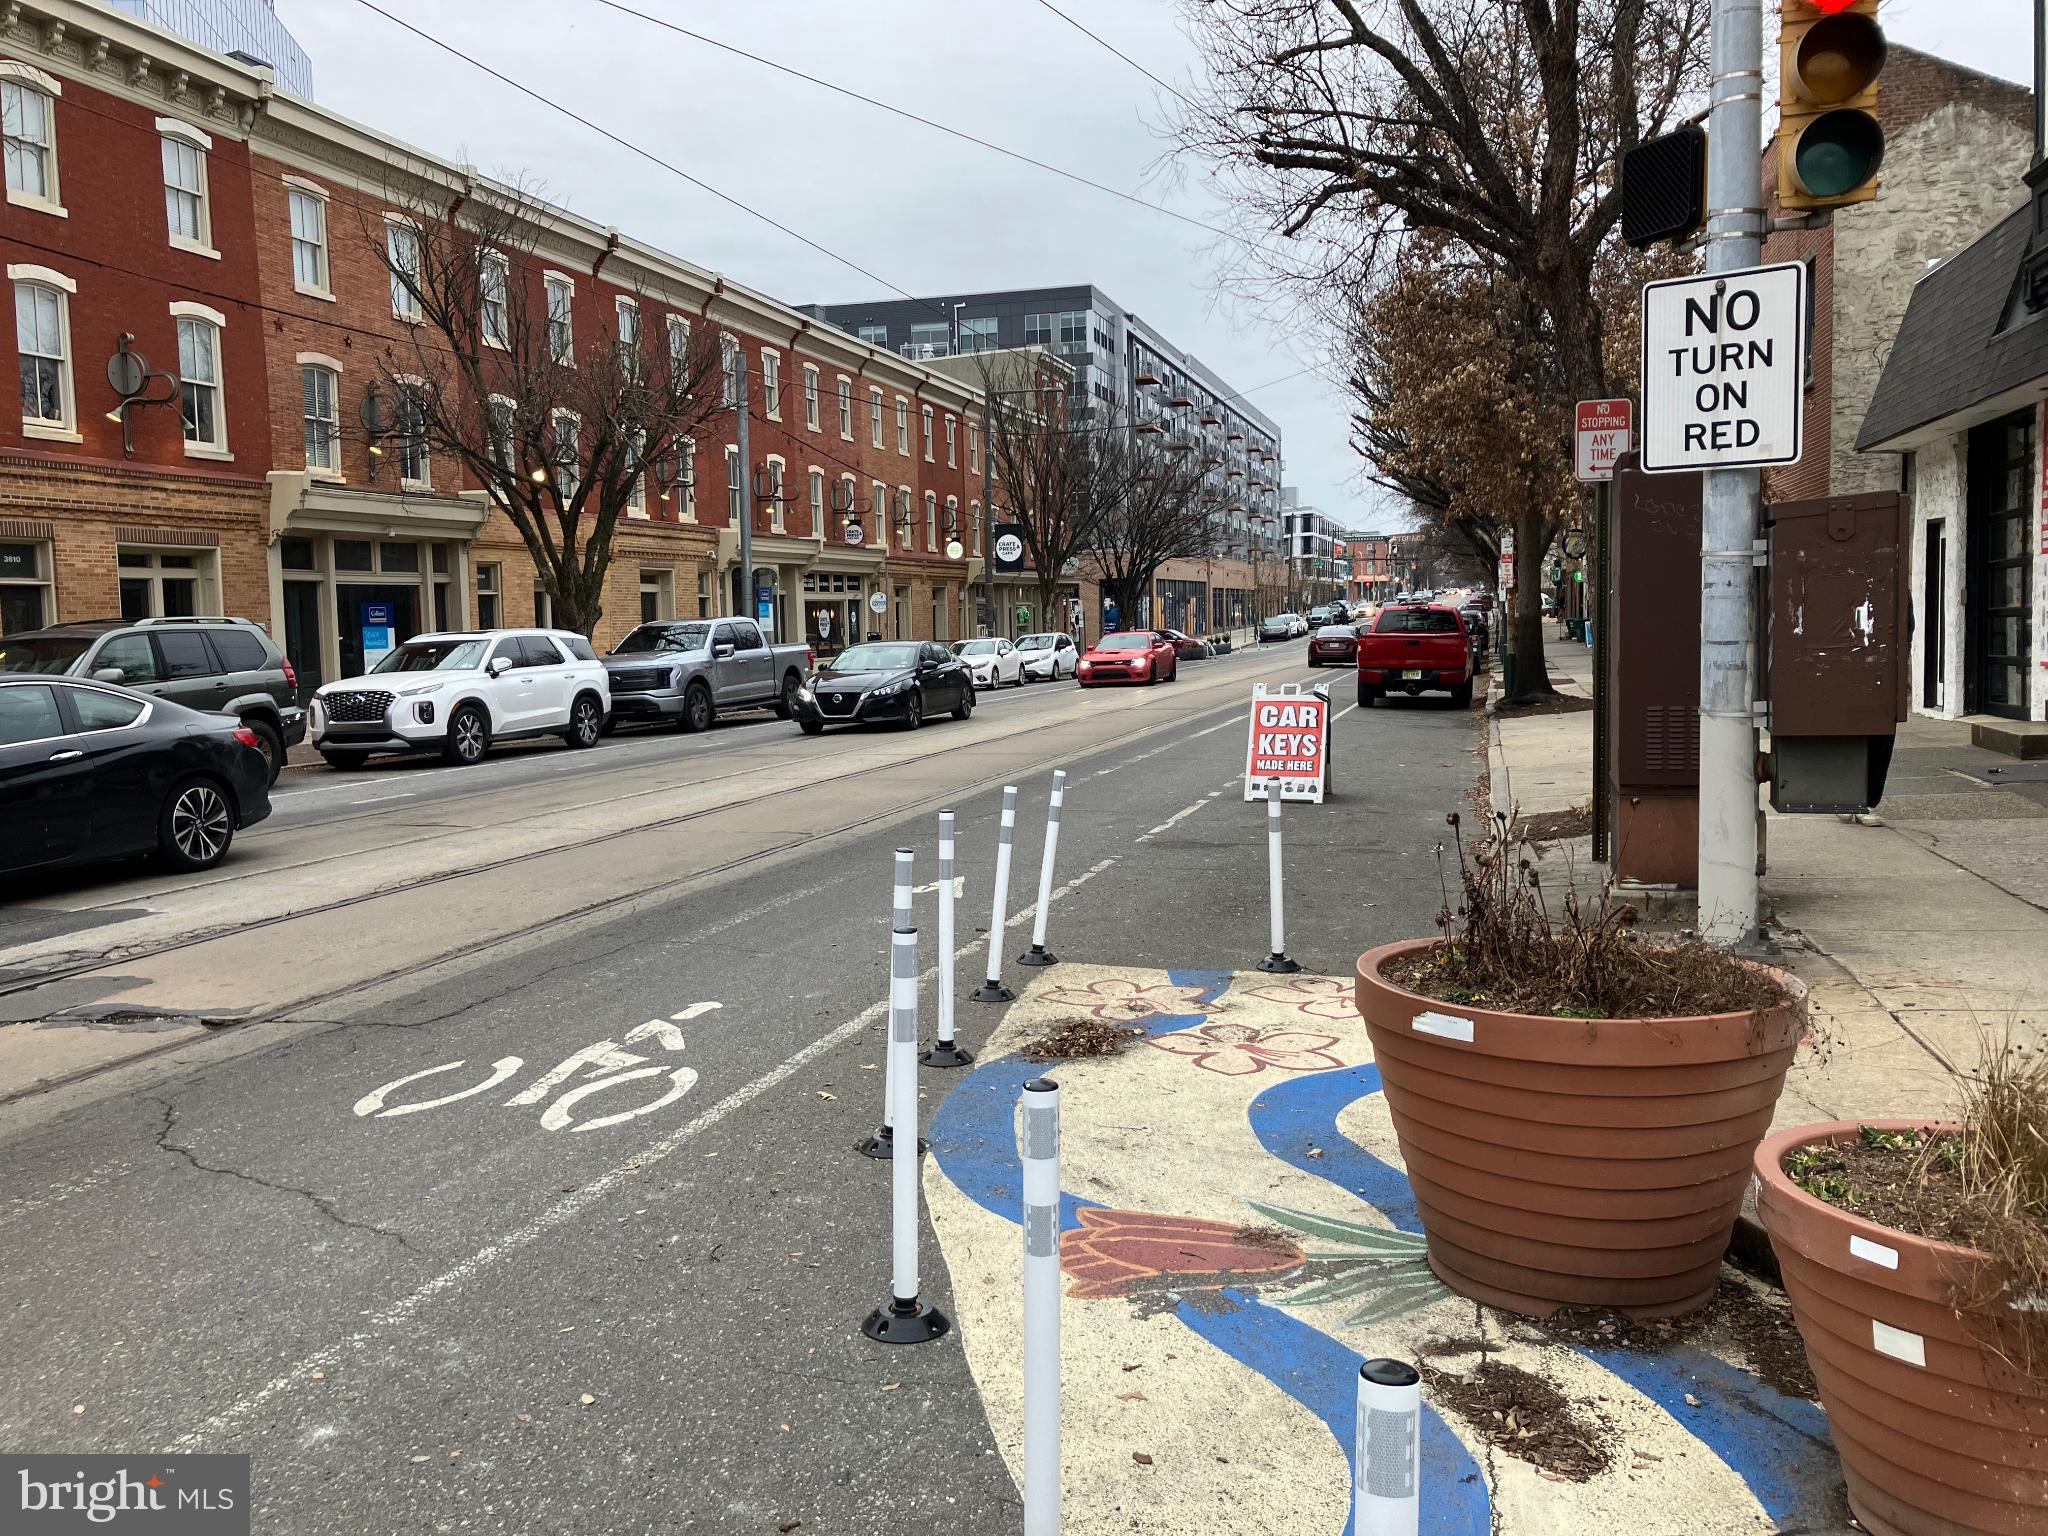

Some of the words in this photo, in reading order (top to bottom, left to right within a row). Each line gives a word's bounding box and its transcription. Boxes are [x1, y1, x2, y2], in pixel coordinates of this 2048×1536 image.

[1685, 290, 1761, 337] NO
[1668, 338, 1774, 377] TURN
[1695, 380, 1748, 413] ON
[1596, 404, 1610, 415] NO
[1581, 416, 1626, 428] STOPPING
[1592, 433, 1616, 447] ANY
[1684, 418, 1760, 451] RED
[1590, 447, 1617, 461] TIME
[1259, 705, 1319, 729] CAR
[1258, 733, 1318, 757] KEYS
[1256, 760, 1285, 771] MADE
[1286, 760, 1314, 771] HERE
